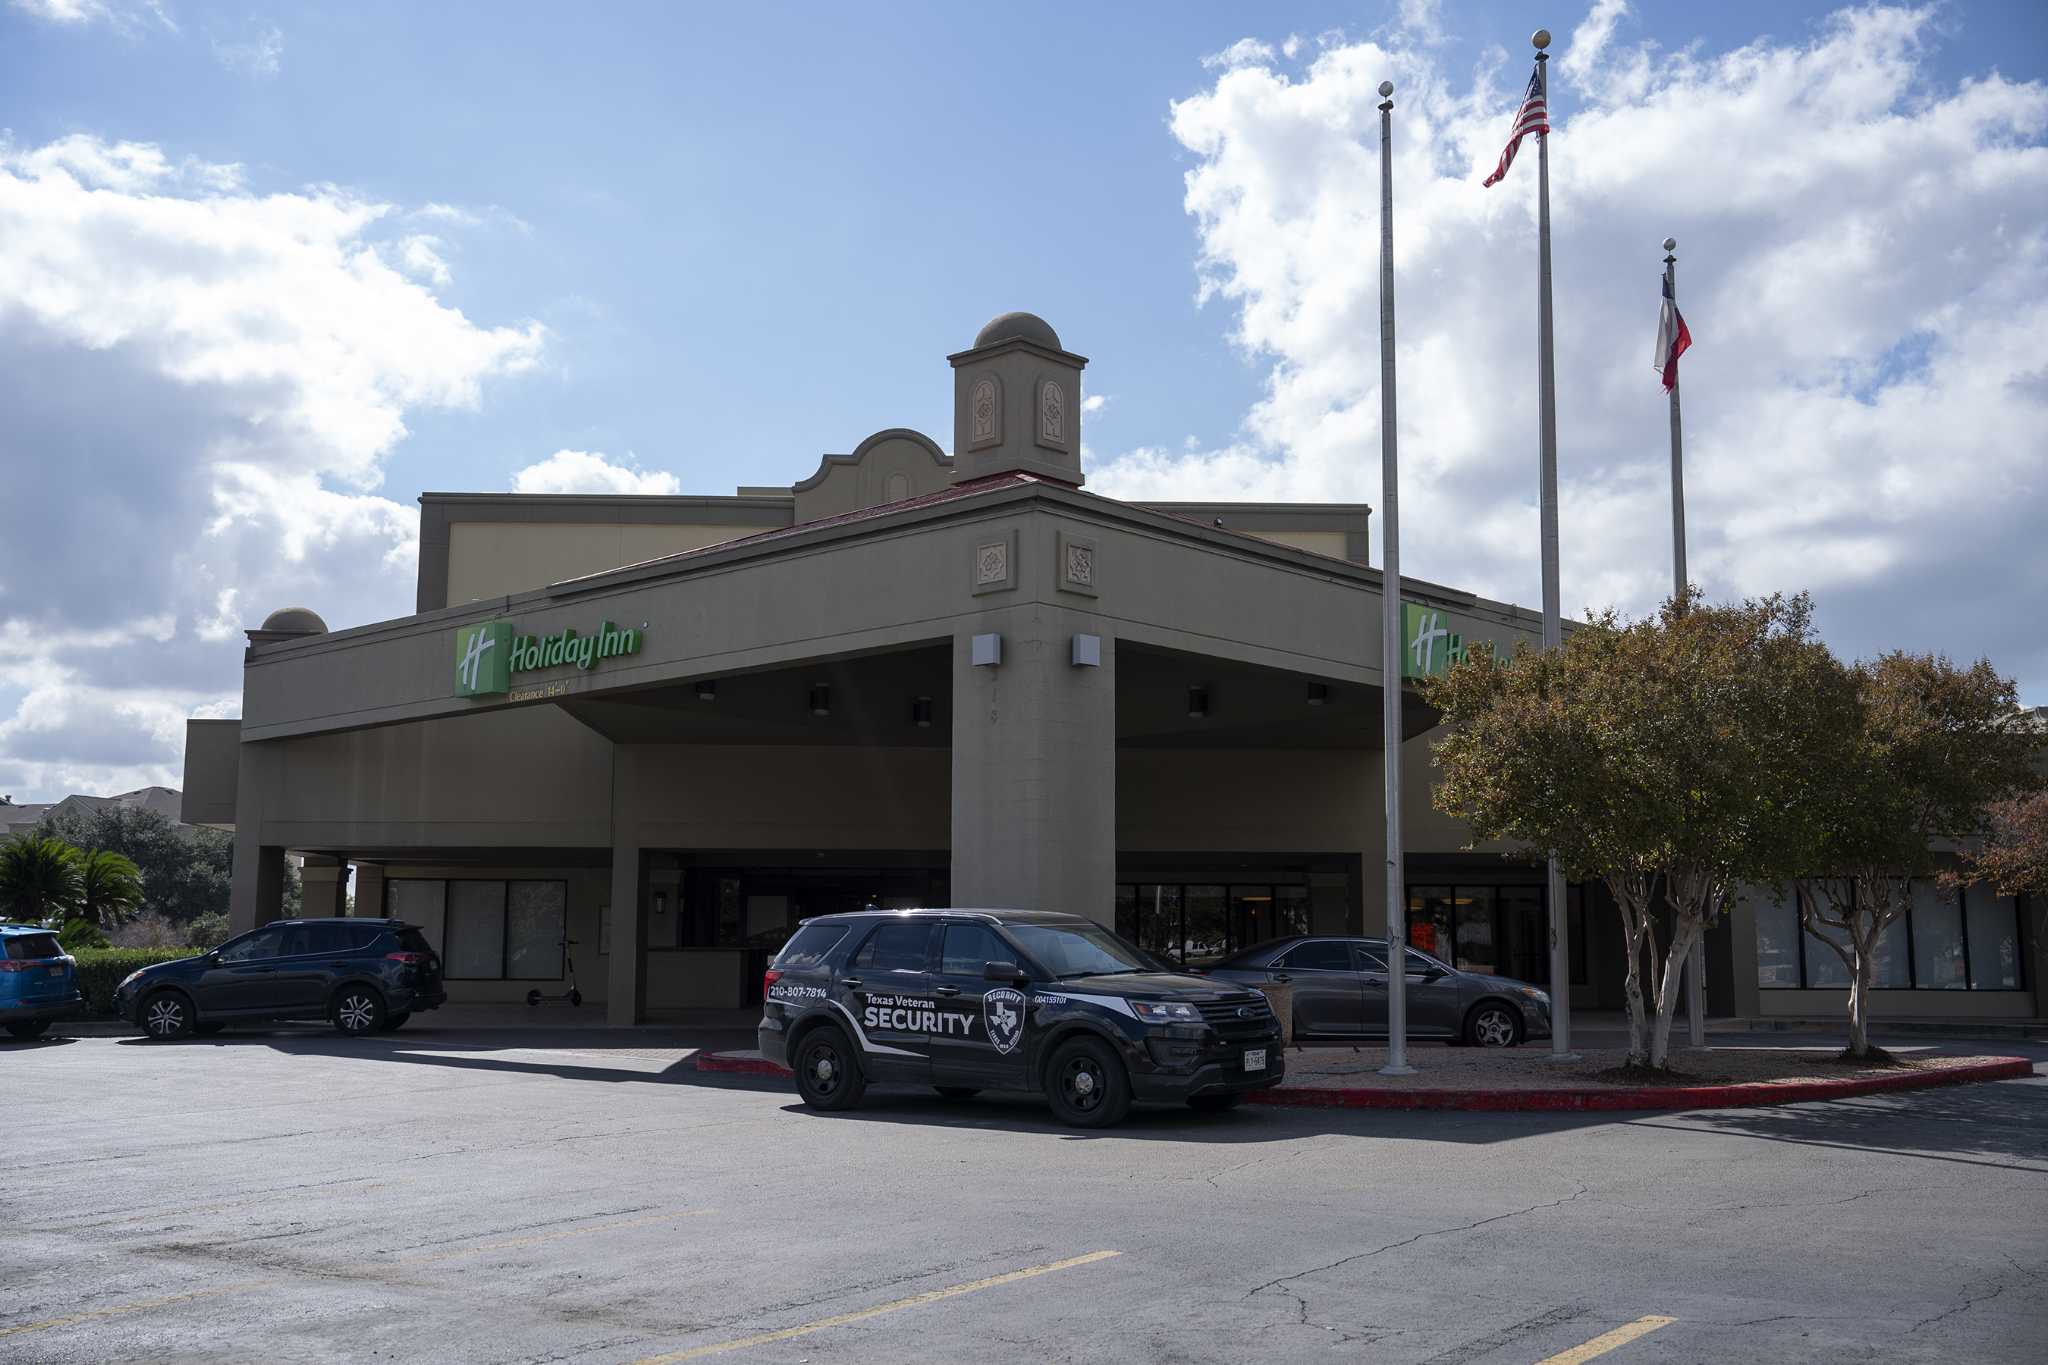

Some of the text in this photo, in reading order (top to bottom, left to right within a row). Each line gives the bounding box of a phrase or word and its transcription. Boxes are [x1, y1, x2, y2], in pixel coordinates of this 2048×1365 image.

[509, 620, 640, 672] Holiday Inn
[770, 986, 827, 998] 210-807-7814
[987, 991, 1022, 1003] SECURITY
[866, 993, 935, 1009] Texas Veteran
[863, 1008, 975, 1035] SECURITY
